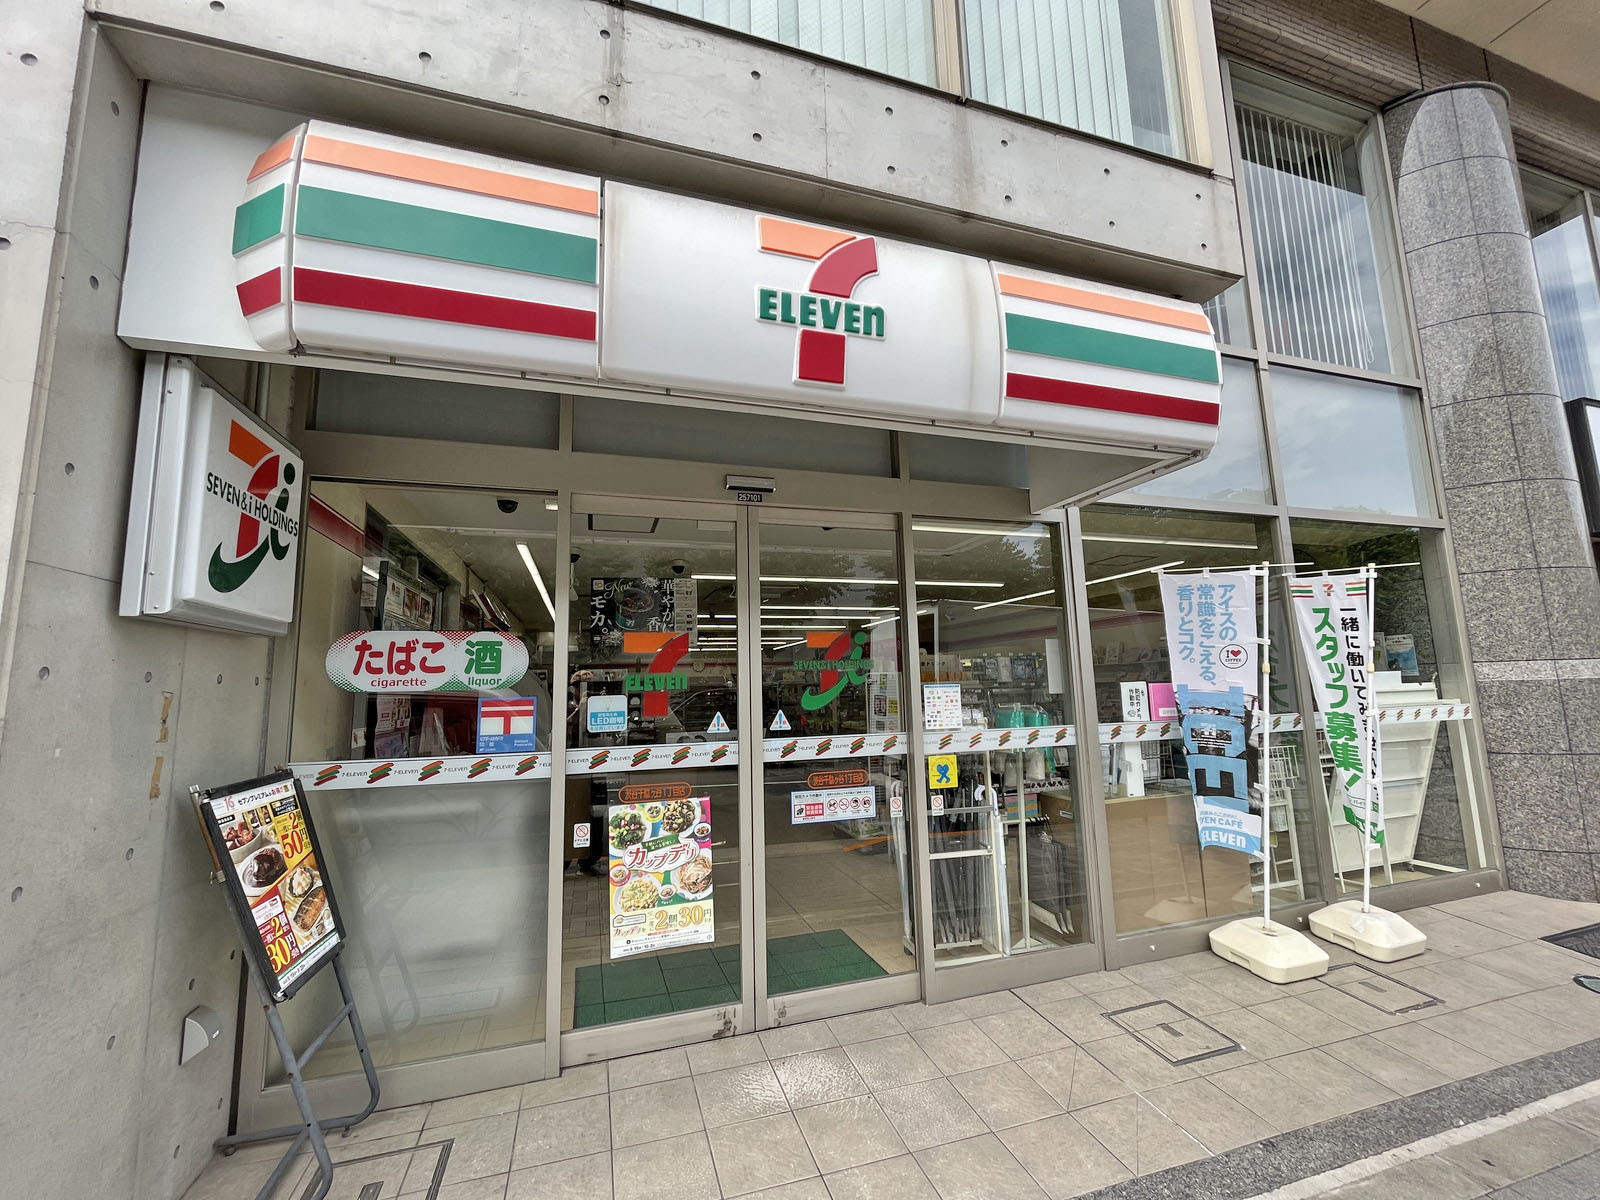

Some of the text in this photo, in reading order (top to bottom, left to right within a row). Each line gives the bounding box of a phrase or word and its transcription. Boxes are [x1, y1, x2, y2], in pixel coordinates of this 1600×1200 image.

[254, 499, 299, 537] HOLDINGS
[1176, 585, 1196, 664] 香りとコク。
[1218, 584, 1238, 641] アイスの
[1197, 583, 1217, 686] 常識をこえる、
[353, 638, 502, 676] たばこ 酒
[370, 676, 502, 689] cigarette liquor
[1218, 818, 1244, 829] CAFÉ
[281, 830, 304, 859] 50
[628, 842, 695, 868] カップデリ
[271, 916, 284, 938] 2
[655, 909, 669, 931] 2
[679, 905, 704, 927] 30
[265, 937, 291, 973] 30
